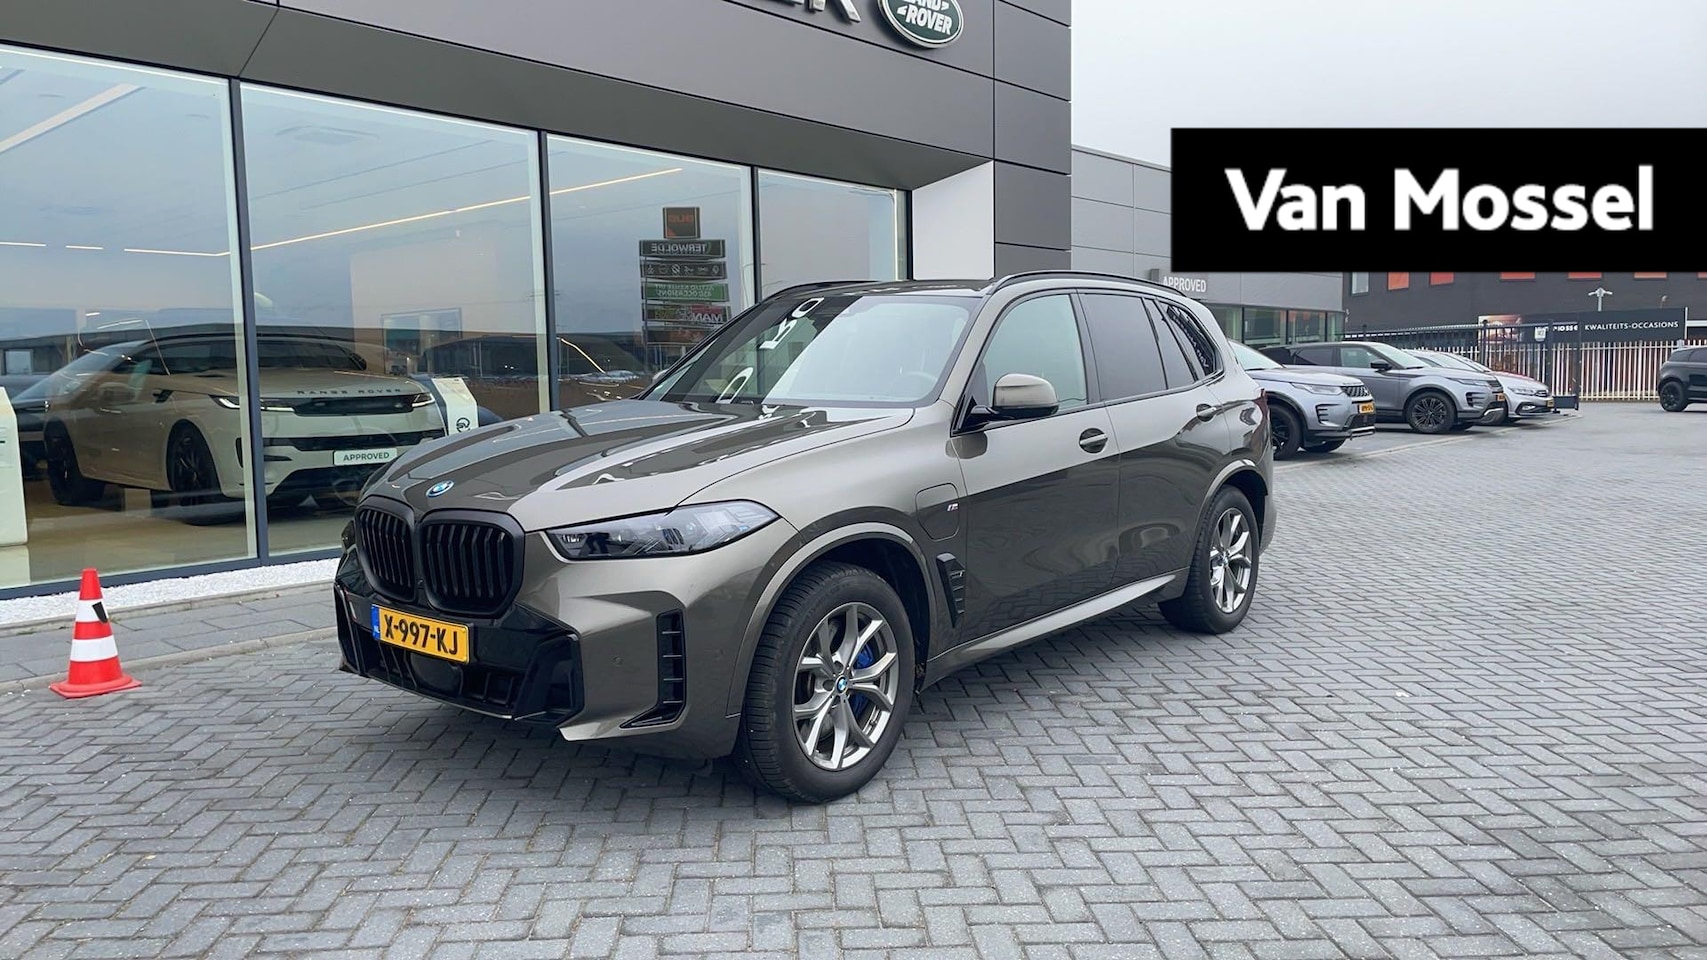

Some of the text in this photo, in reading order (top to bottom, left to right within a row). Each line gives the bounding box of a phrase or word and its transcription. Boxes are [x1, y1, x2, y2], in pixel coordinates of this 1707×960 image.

[905, 4, 953, 35] ROVER
[1163, 276, 1207, 292] APPROVED
[1584, 321, 1679, 330] KWALITEITS-OCCASIONS
[343, 452, 390, 461] APPROVED
[384, 614, 458, 655] X-997-KJ
